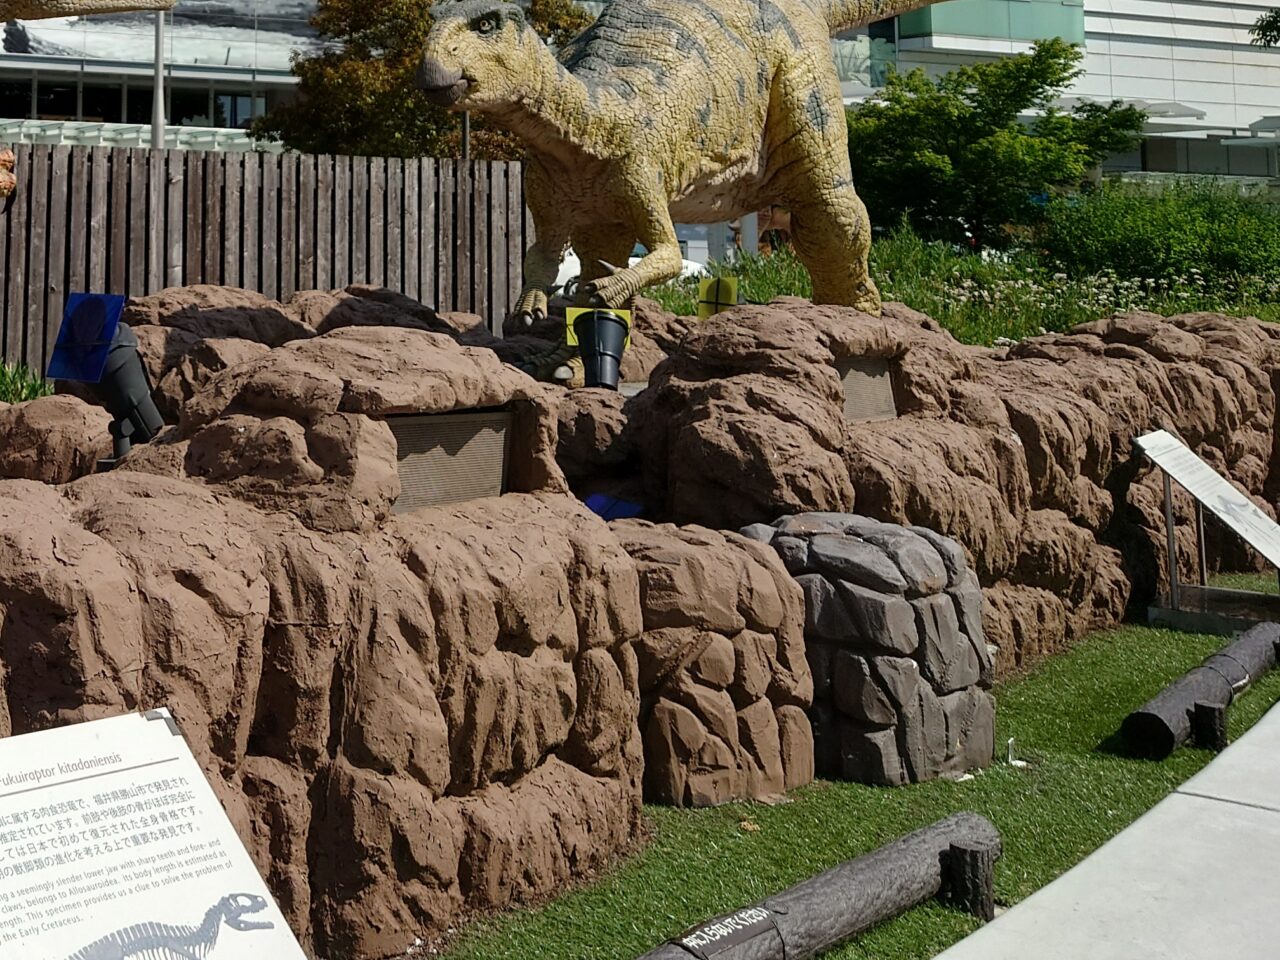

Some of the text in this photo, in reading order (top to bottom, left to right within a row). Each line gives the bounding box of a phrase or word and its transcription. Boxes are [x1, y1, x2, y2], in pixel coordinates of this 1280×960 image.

[57, 751, 122, 775] kitadaniensis
[1, 903, 25, 913] claws,
[26, 894, 57, 907] belongs
[133, 869, 152, 879] body
[152, 862, 176, 873] length
[185, 851, 218, 866] estimated
[17, 881, 54, 896] seemingly
[83, 869, 104, 878] lower
[120, 860, 136, 869] with
[137, 856, 156, 865] sharp
[157, 850, 175, 860] teeth
[25, 912, 43, 920] This
[45, 902, 82, 916] specimen
[84, 892, 116, 907] provides
[135, 884, 150, 892] clue
[161, 876, 180, 885] solve
[195, 864, 224, 877] problem
[19, 926, 39, 937] Early
[682, 907, 770, 949] 中に入らないでください
